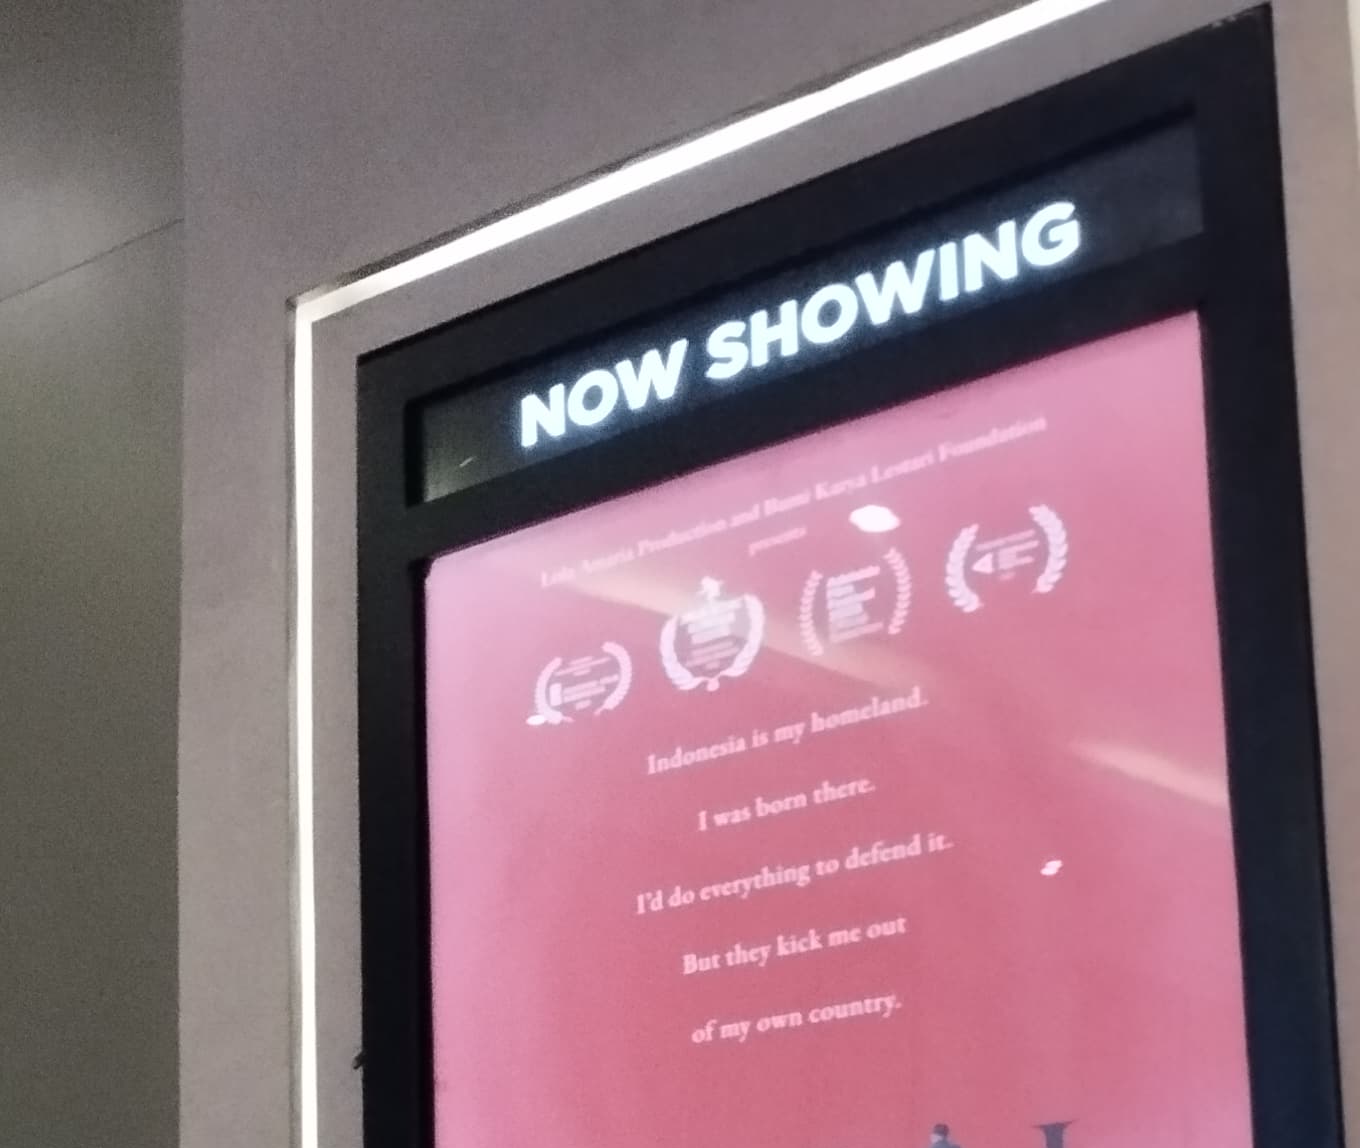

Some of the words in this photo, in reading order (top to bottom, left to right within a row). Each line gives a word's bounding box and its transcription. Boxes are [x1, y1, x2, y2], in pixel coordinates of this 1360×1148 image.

[520, 339, 688, 449] NOW
[705, 201, 1081, 381] SHOWING
[637, 516, 726, 556] Production
[729, 504, 761, 531] and
[938, 417, 1047, 463] Foundation
[647, 736, 747, 774] Indonesia
[753, 728, 769, 747] is
[774, 722, 806, 744] my
[811, 686, 929, 733] homeland.
[697, 811, 708, 831] I
[714, 806, 751, 827] was
[755, 791, 807, 818] born
[813, 776, 876, 803] there.
[668, 886, 695, 908] do
[700, 862, 810, 901] everything
[816, 858, 839, 876] to
[845, 834, 921, 871] defend
[928, 832, 954, 853] it.
[682, 953, 720, 975] But
[726, 942, 771, 967] they
[777, 929, 823, 956] kick
[828, 927, 861, 947] me
[866, 917, 907, 938] out
[691, 1020, 717, 1044] of
[720, 1018, 750, 1043] my
[756, 1011, 803, 1032] own
[808, 993, 902, 1024] country.
